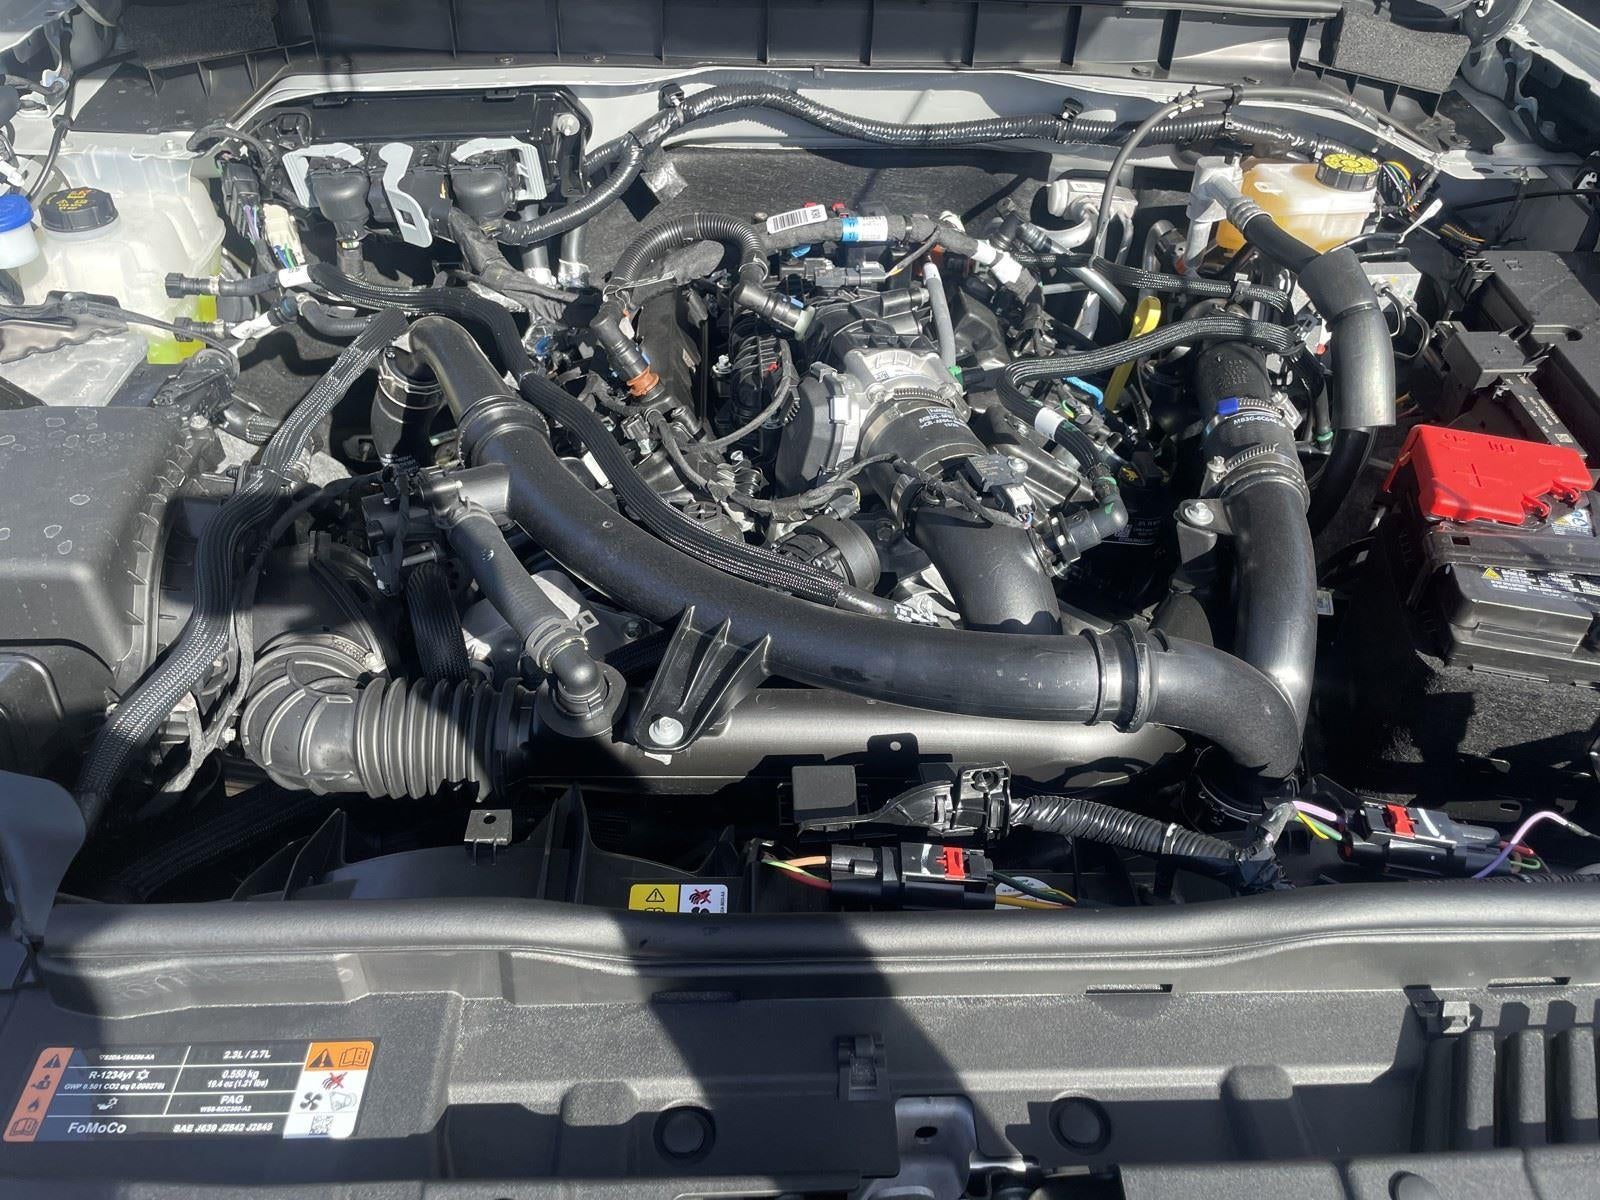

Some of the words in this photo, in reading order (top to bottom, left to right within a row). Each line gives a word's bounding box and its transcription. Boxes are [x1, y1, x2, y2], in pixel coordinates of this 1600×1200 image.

[251, 1049, 272, 1059] 2.7L
[88, 1069, 135, 1082] R-1234yf
[247, 1069, 260, 1081] kg
[220, 1094, 245, 1105] PAG
[67, 1121, 127, 1134] FoMoCo
[172, 1124, 194, 1133] SAE
